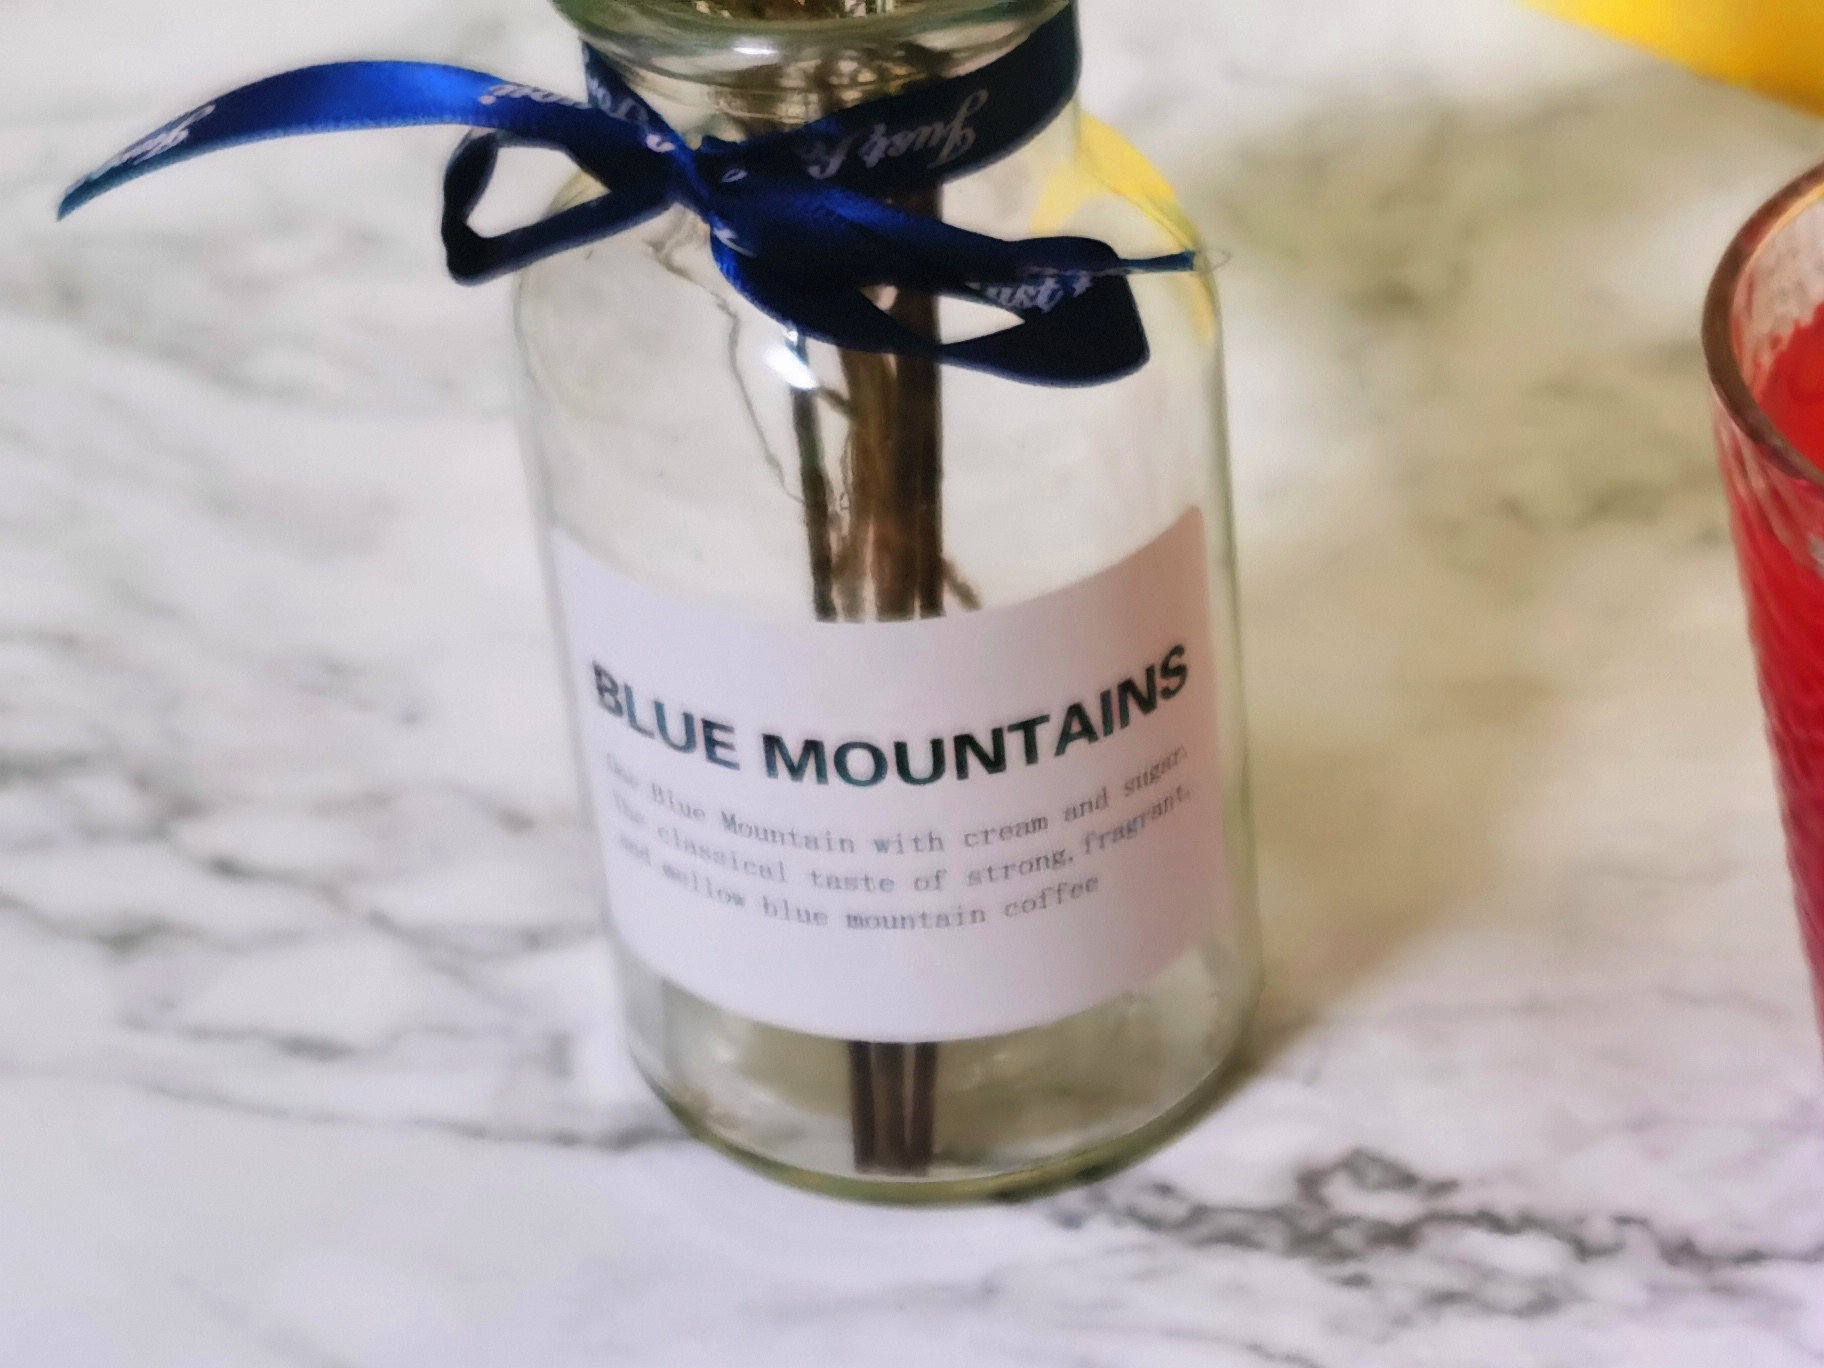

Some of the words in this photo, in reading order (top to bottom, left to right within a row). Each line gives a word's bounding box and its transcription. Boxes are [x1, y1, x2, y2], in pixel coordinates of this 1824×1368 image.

[592, 658, 742, 771] BLUE
[762, 643, 1189, 788] MOUNTAINS
[650, 781, 706, 820] Blue
[720, 809, 856, 854] Mountain
[872, 830, 946, 855] with
[963, 815, 1049, 848] cream
[1063, 785, 1109, 822] and
[656, 825, 789, 883] classical
[808, 869, 896, 893] taste
[913, 868, 948, 892] of
[661, 860, 746, 908] mellow
[762, 895, 829, 926] blue
[845, 904, 987, 931] mountain
[1004, 876, 1100, 919] coffee
